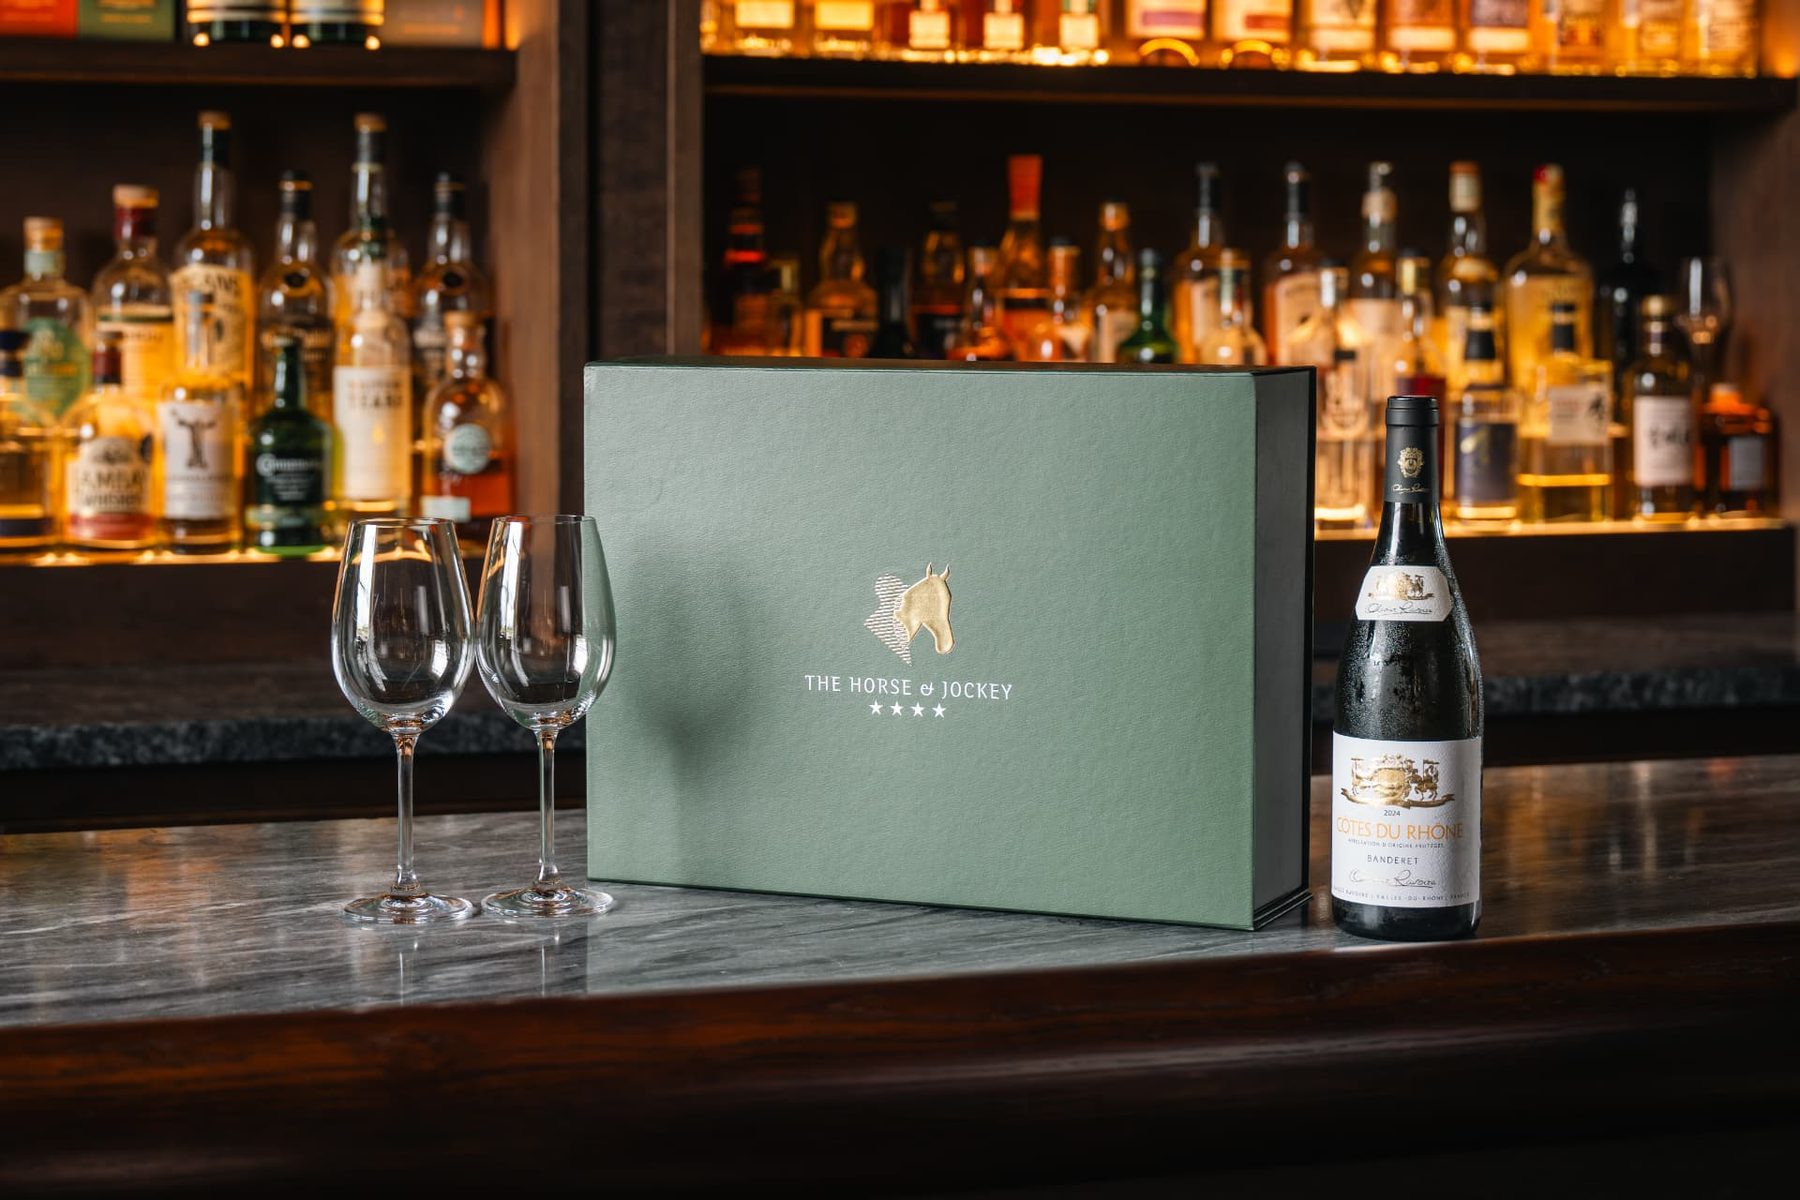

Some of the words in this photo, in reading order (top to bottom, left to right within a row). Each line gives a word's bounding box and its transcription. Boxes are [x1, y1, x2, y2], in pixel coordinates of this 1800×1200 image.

[804, 674, 841, 692] THE
[850, 677, 912, 696] HORSE
[920, 681, 934, 697] &
[942, 681, 1013, 700] JOCKEY
[1383, 809, 1401, 817] 2024
[1376, 822, 1401, 840] DU
[1407, 821, 1463, 841] RHÔNE
[1367, 854, 1420, 866] BANDERET
